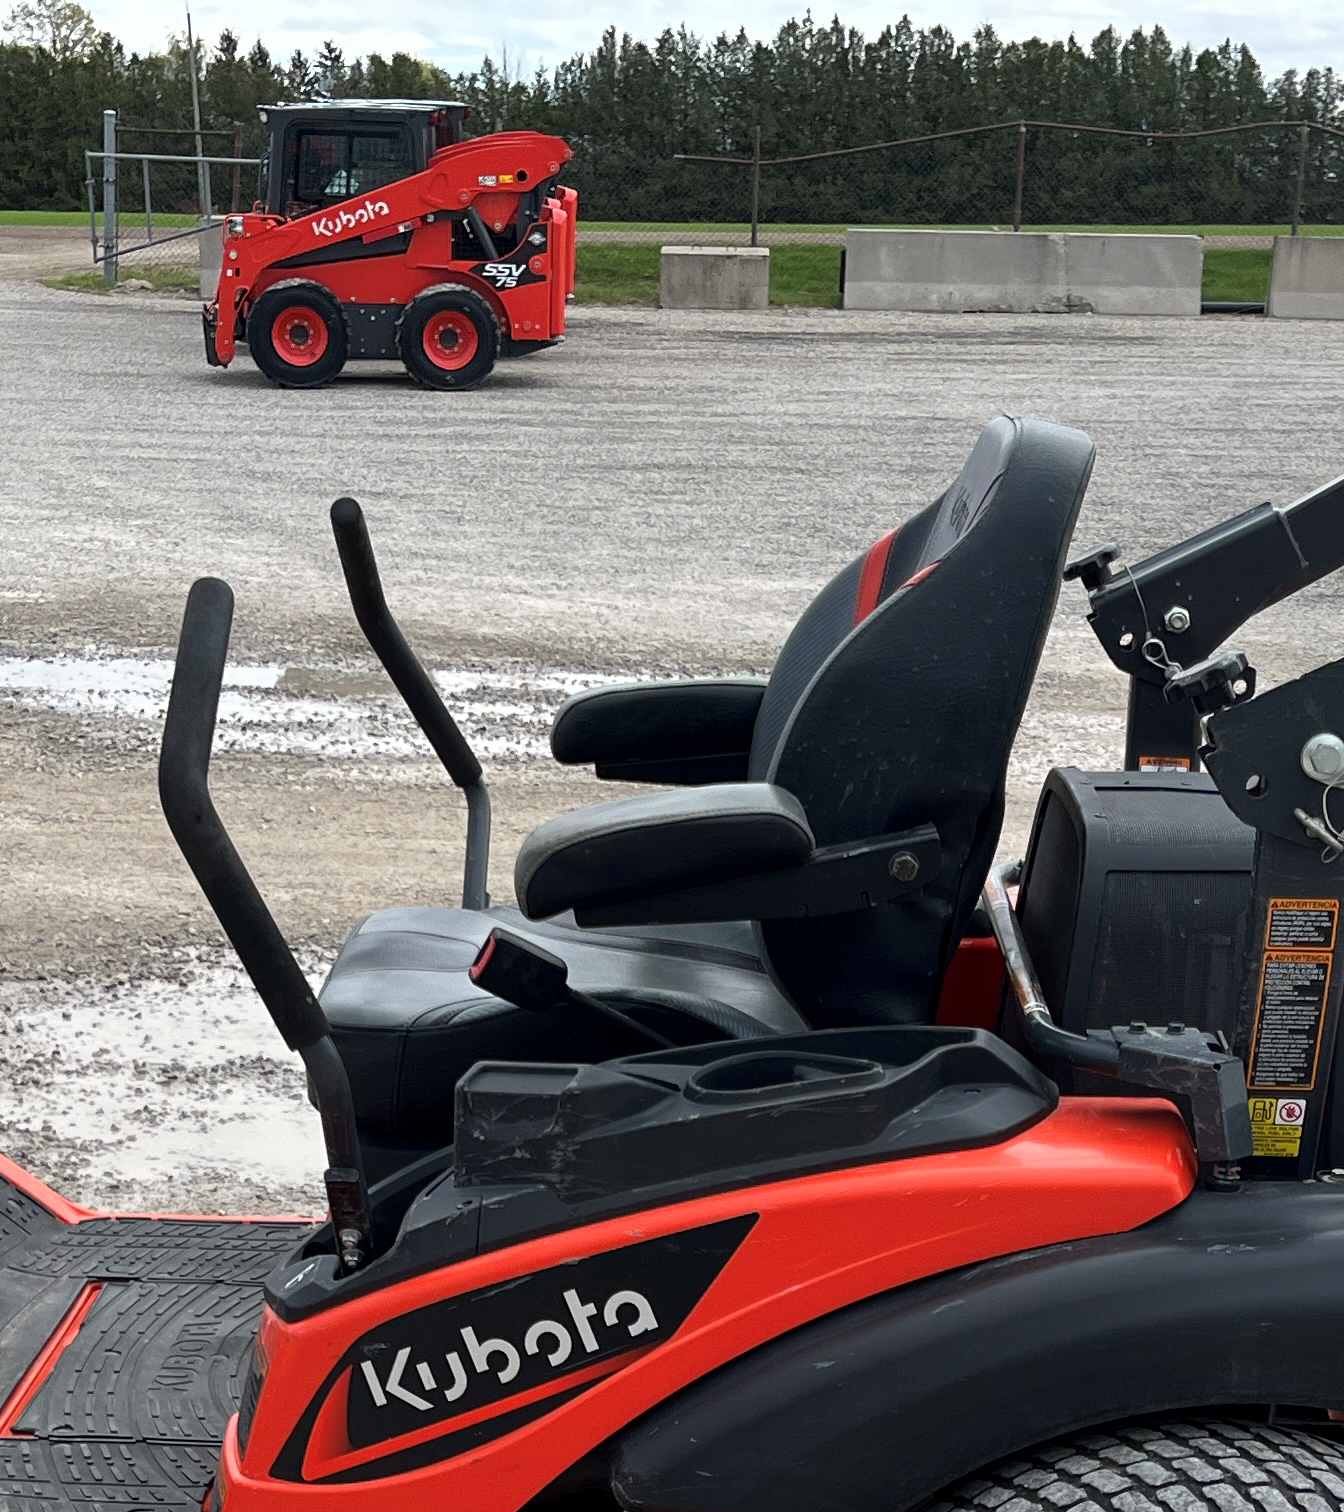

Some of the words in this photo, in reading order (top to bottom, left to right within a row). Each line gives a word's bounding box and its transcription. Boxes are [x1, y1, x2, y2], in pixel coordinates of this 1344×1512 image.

[312, 200, 390, 236] Kubota
[482, 263, 526, 276] SSV
[496, 276, 518, 288] 75
[1279, 901, 1337, 909] ADVERTENCIA
[1276, 953, 1330, 962] ADVERTENCIA
[360, 1288, 659, 1411] Kubota
[146, 1320, 223, 1393] KUBOTA
